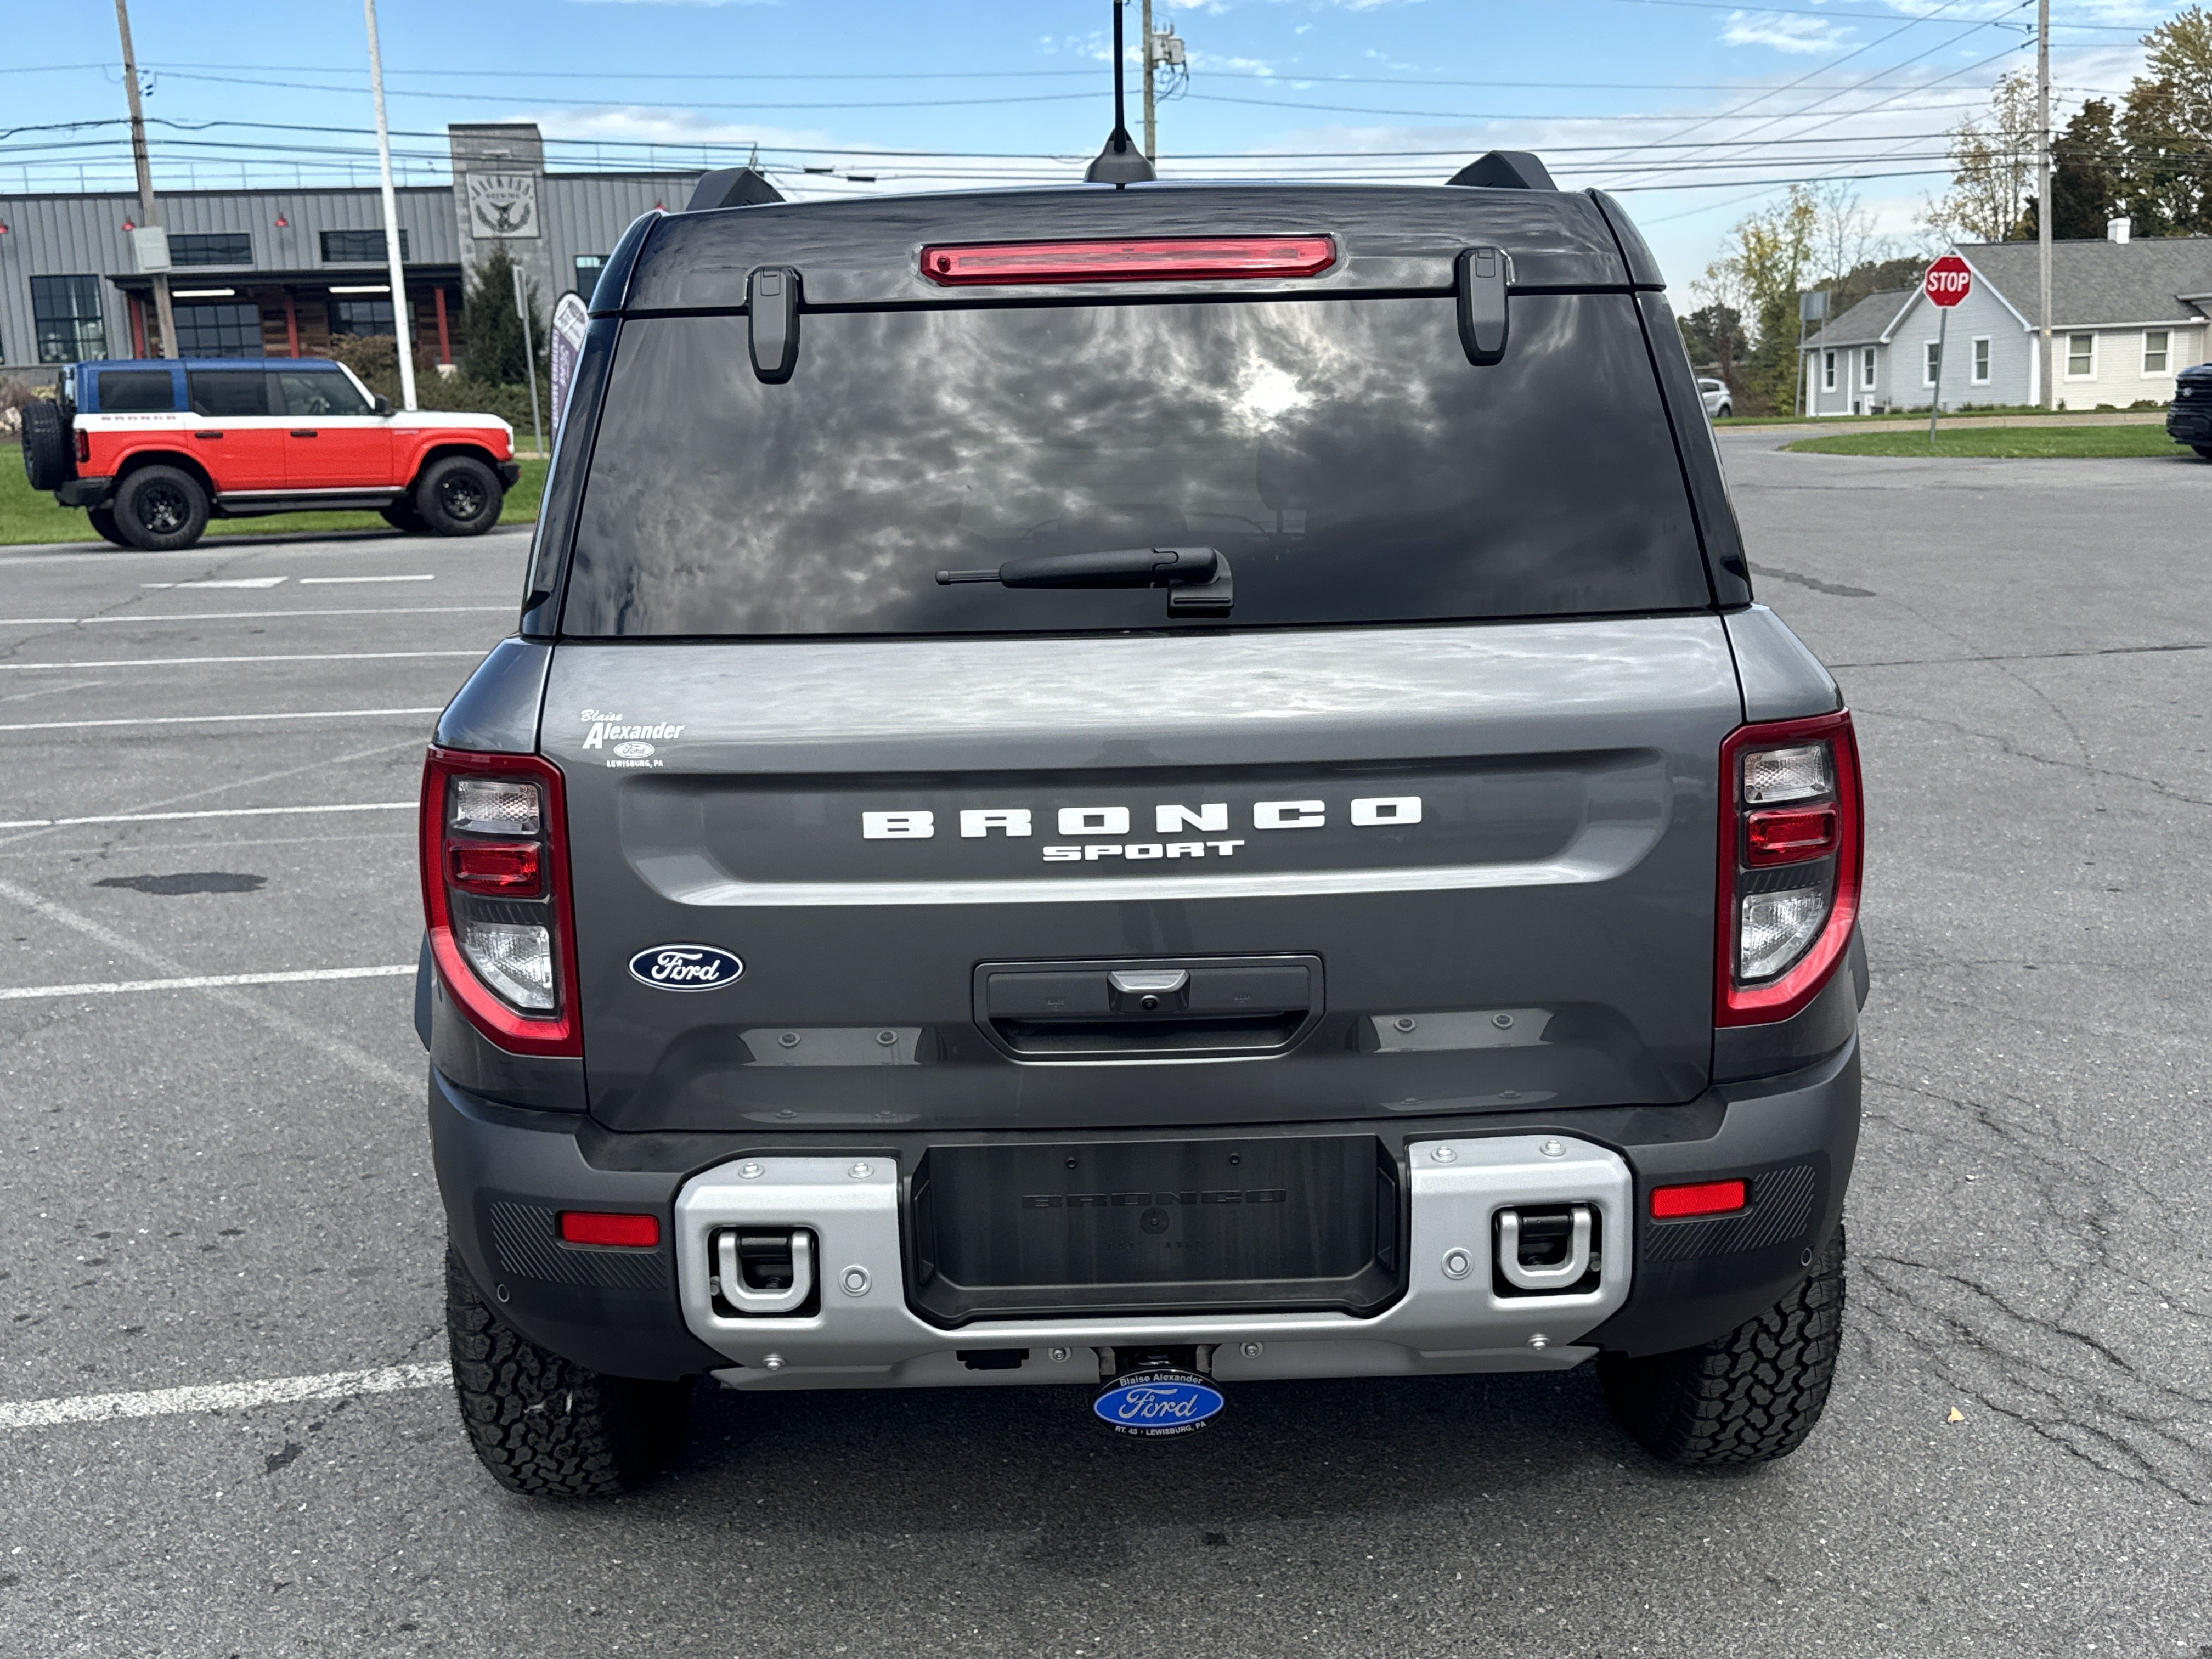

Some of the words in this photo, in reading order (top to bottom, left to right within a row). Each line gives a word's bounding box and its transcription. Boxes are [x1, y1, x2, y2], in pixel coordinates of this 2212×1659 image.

[1927, 271, 1969, 292] STOP
[580, 709, 624, 722] Blaise
[582, 721, 685, 749] Alexander
[622, 744, 646, 755] Ford
[607, 759, 652, 768] LEWISBURG,
[862, 796, 1423, 839] BRONCO
[1043, 840, 1245, 861] SPORT
[651, 951, 721, 980] Ford
[1022, 1189, 1287, 1208] BRONCO
[1119, 1376, 1150, 1387] Blaise
[1153, 1373, 1203, 1385] Alexander
[1118, 1388, 1199, 1419] Ford
[1115, 1425, 1127, 1434] RT.
[1146, 1425, 1194, 1436] LEWISBURG,
[1195, 1421, 1206, 1430] PA
